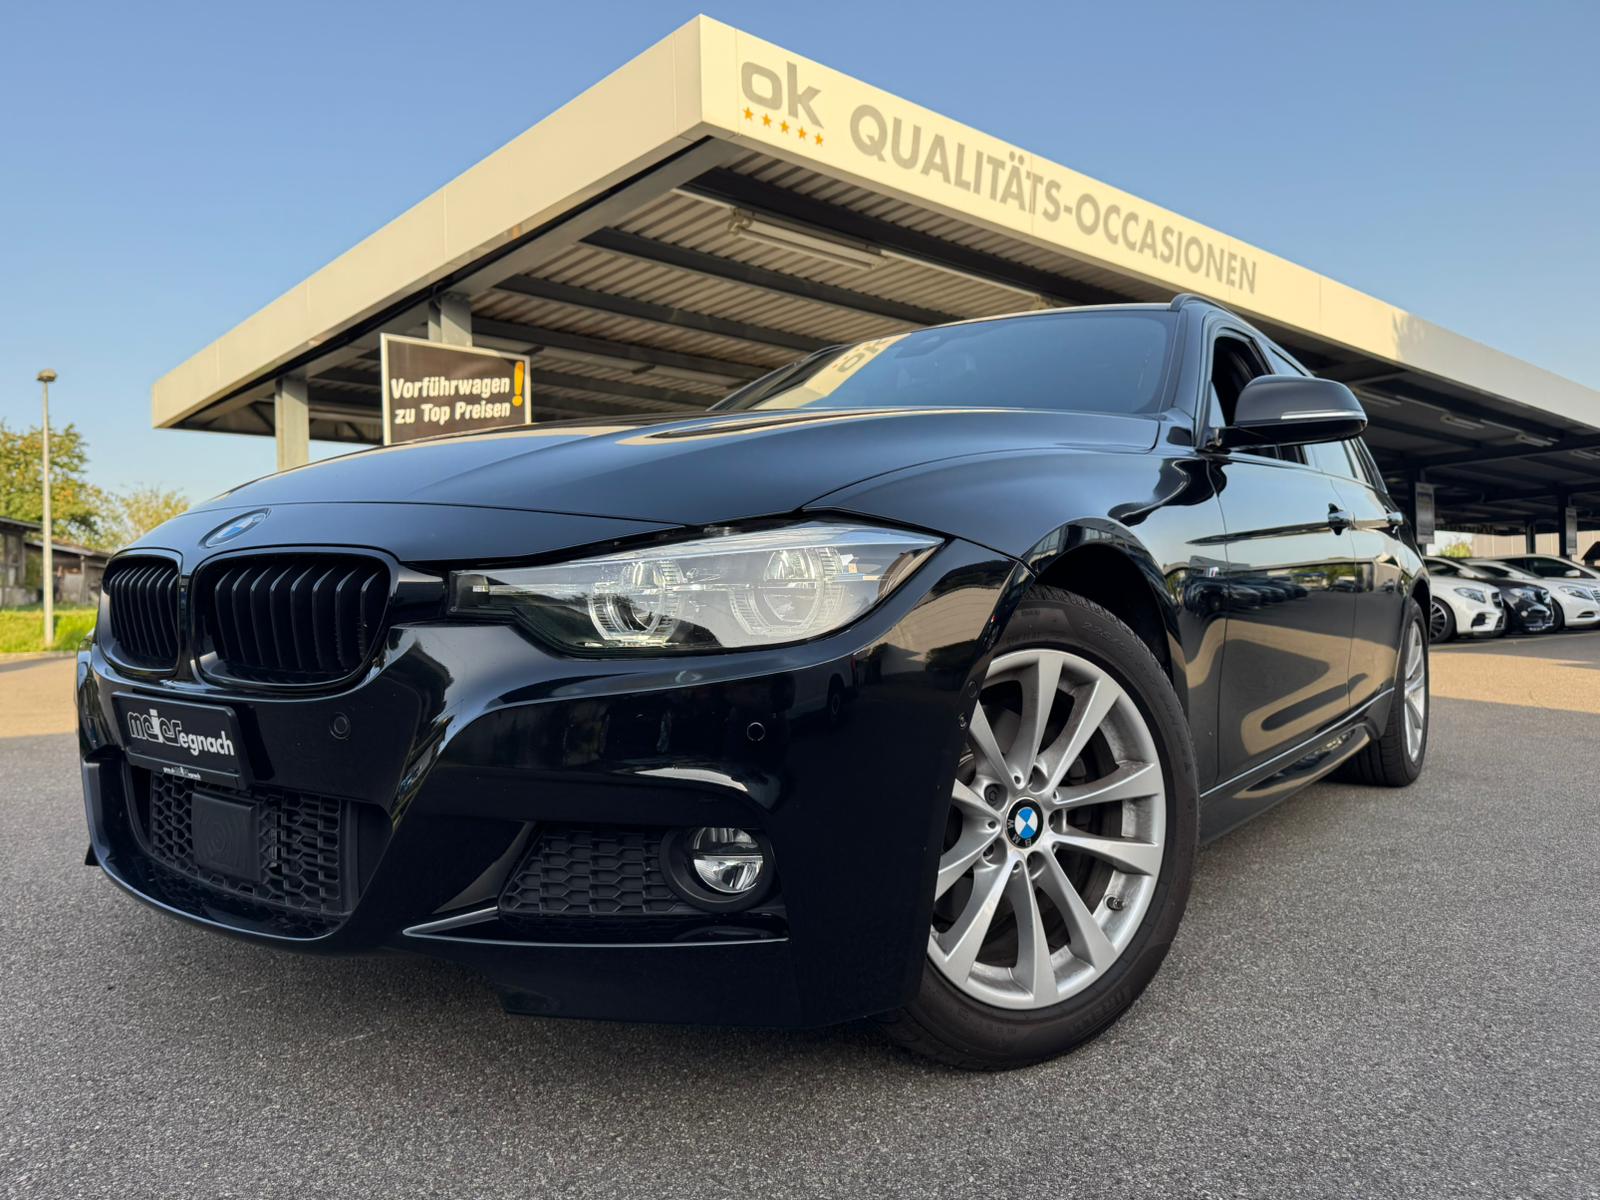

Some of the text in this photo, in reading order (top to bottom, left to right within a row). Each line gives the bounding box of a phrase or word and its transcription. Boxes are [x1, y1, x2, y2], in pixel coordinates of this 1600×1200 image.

[741, 61, 1257, 294] ok QUALITÄTS-OCCASIONEN
[391, 376, 510, 399] Vorführwagen
[395, 401, 511, 425] zu Top Preisen
